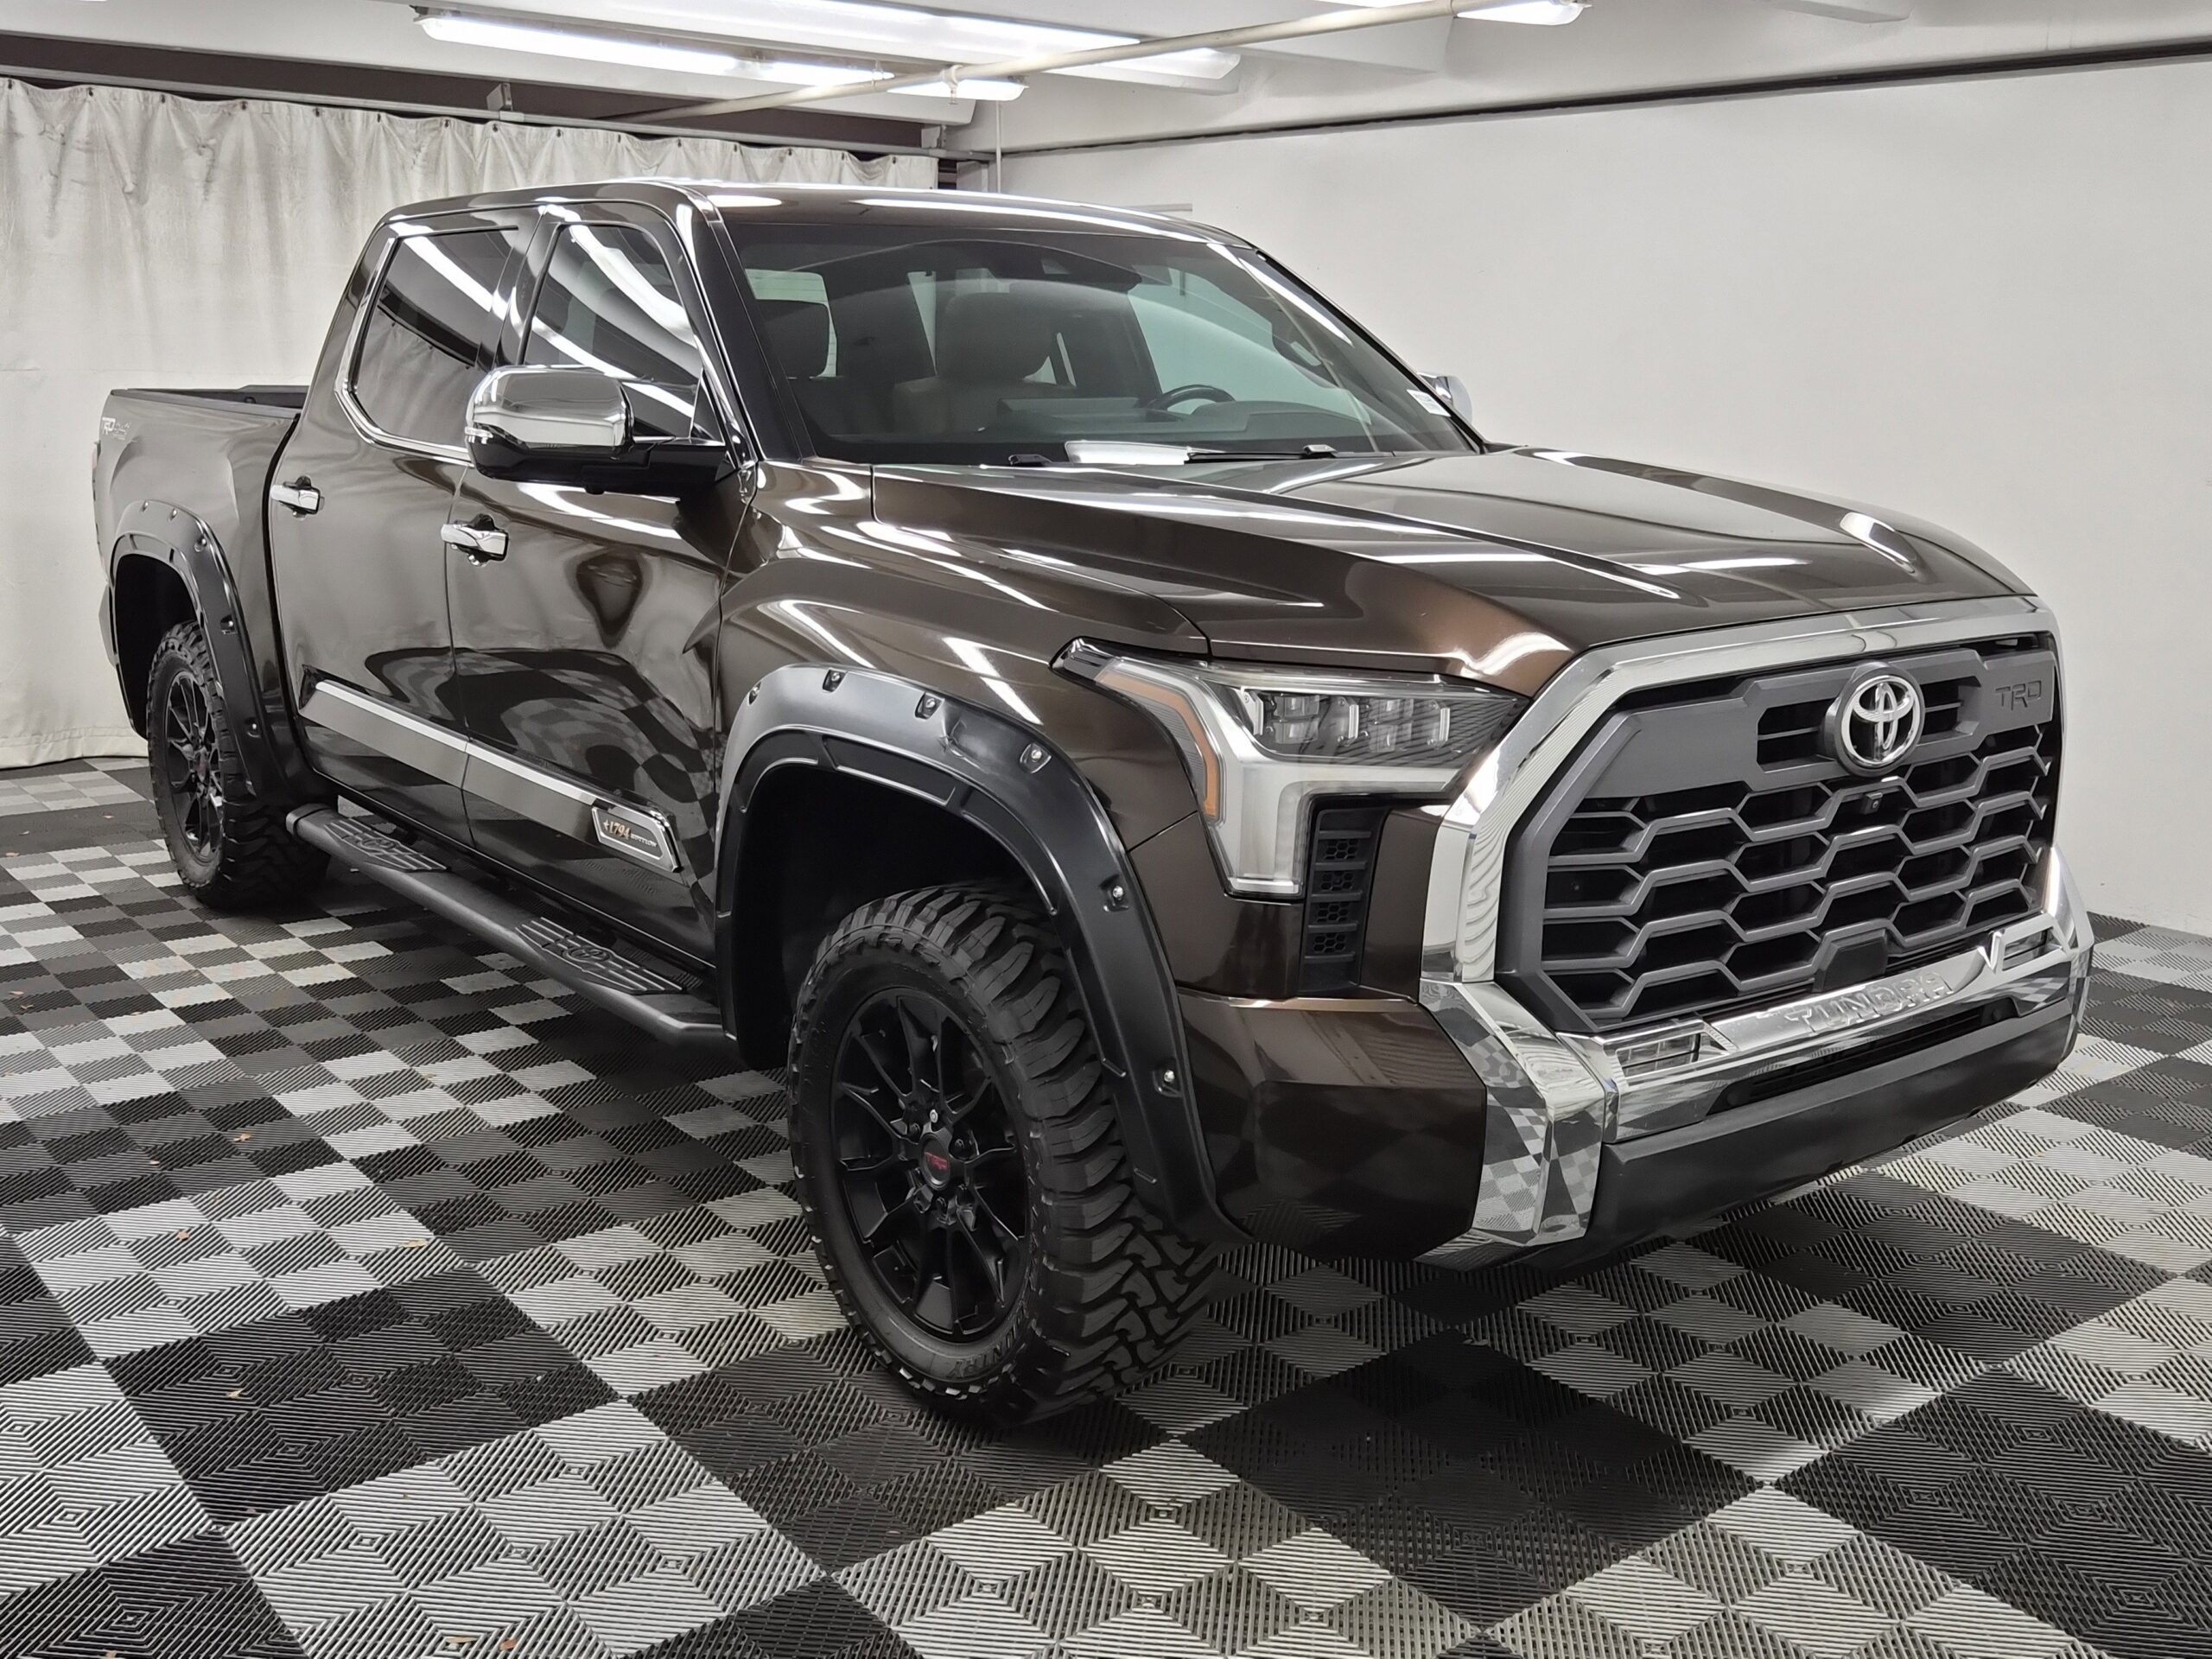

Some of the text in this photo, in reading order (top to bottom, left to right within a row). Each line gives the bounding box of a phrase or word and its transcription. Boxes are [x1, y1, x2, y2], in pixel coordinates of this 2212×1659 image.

[1995, 678, 2042, 711] TRD
[609, 821, 632, 840] 1794
[1783, 972, 1955, 1037] TUNDRA
